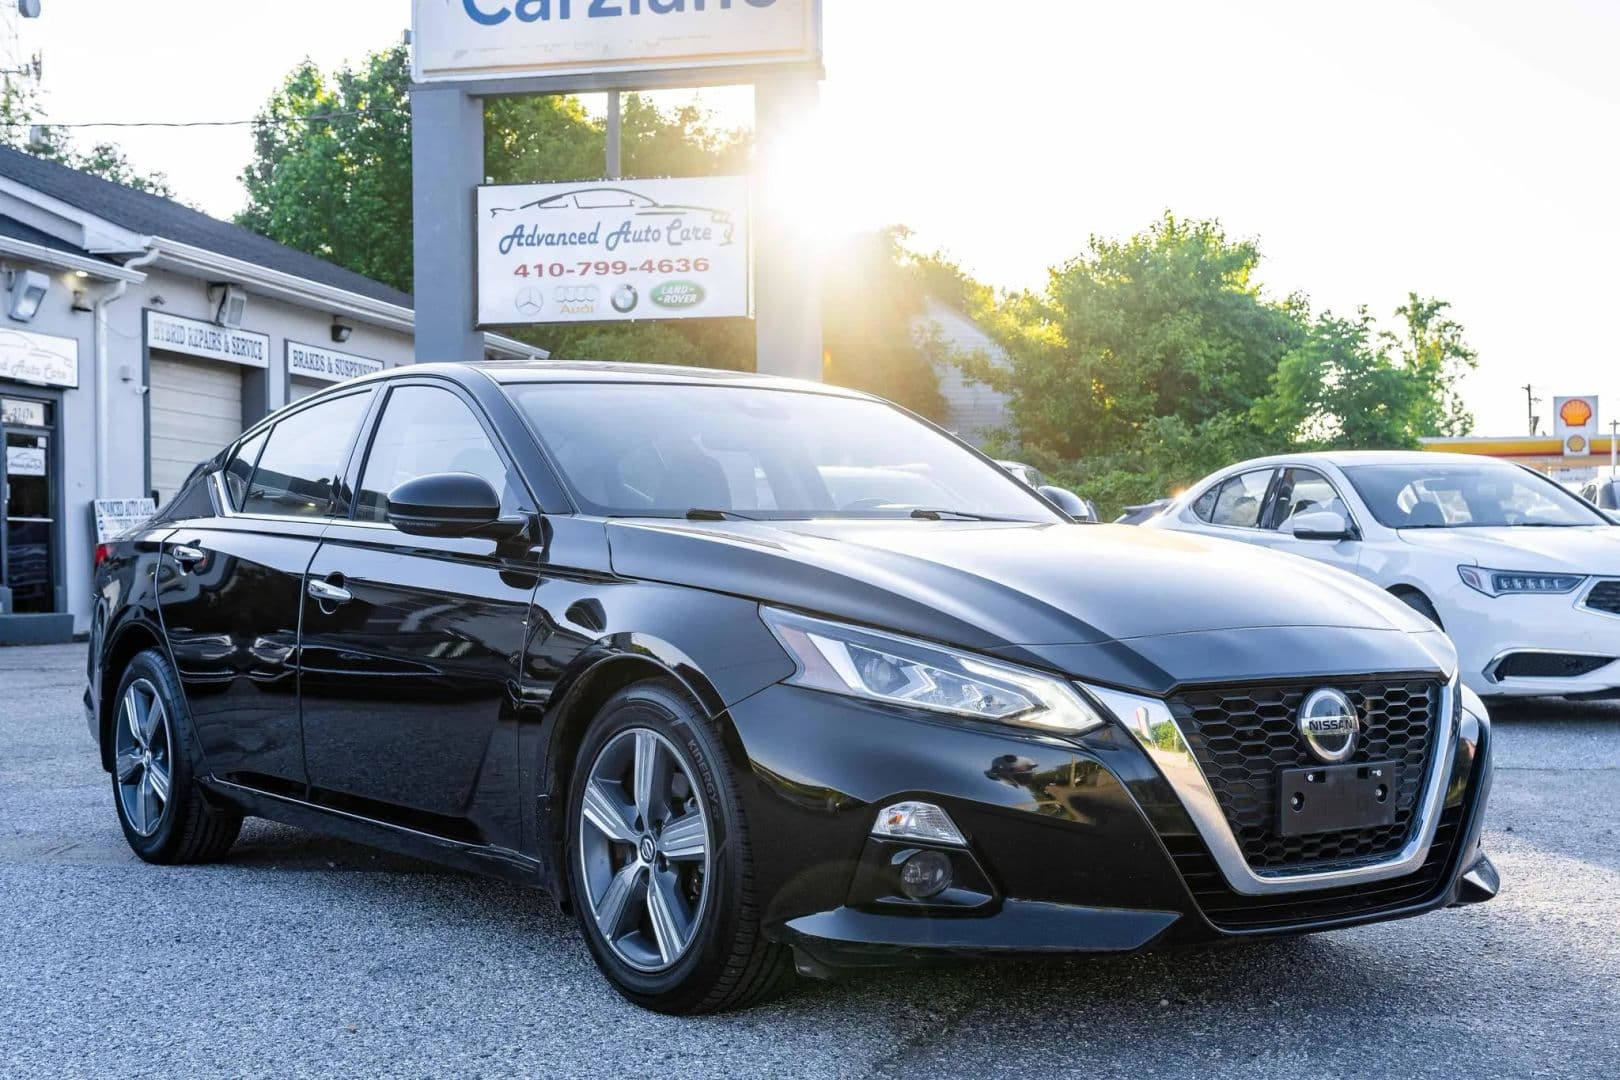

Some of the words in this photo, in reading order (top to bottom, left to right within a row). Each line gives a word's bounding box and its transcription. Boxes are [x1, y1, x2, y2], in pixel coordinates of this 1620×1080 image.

[463, 0, 777, 26] Carz
[499, 221, 601, 255] Advanced
[605, 220, 661, 251] Auto
[665, 218, 712, 246] Care
[513, 258, 710, 278] 410-799-4636
[560, 303, 595, 314] Audi
[187, 327, 222, 352] REPAIRS
[224, 333, 230, 353] &
[231, 336, 263, 360] SERVICE
[293, 350, 325, 372] BRAKES
[327, 357, 333, 374] &
[1308, 719, 1353, 731] NISSAN
